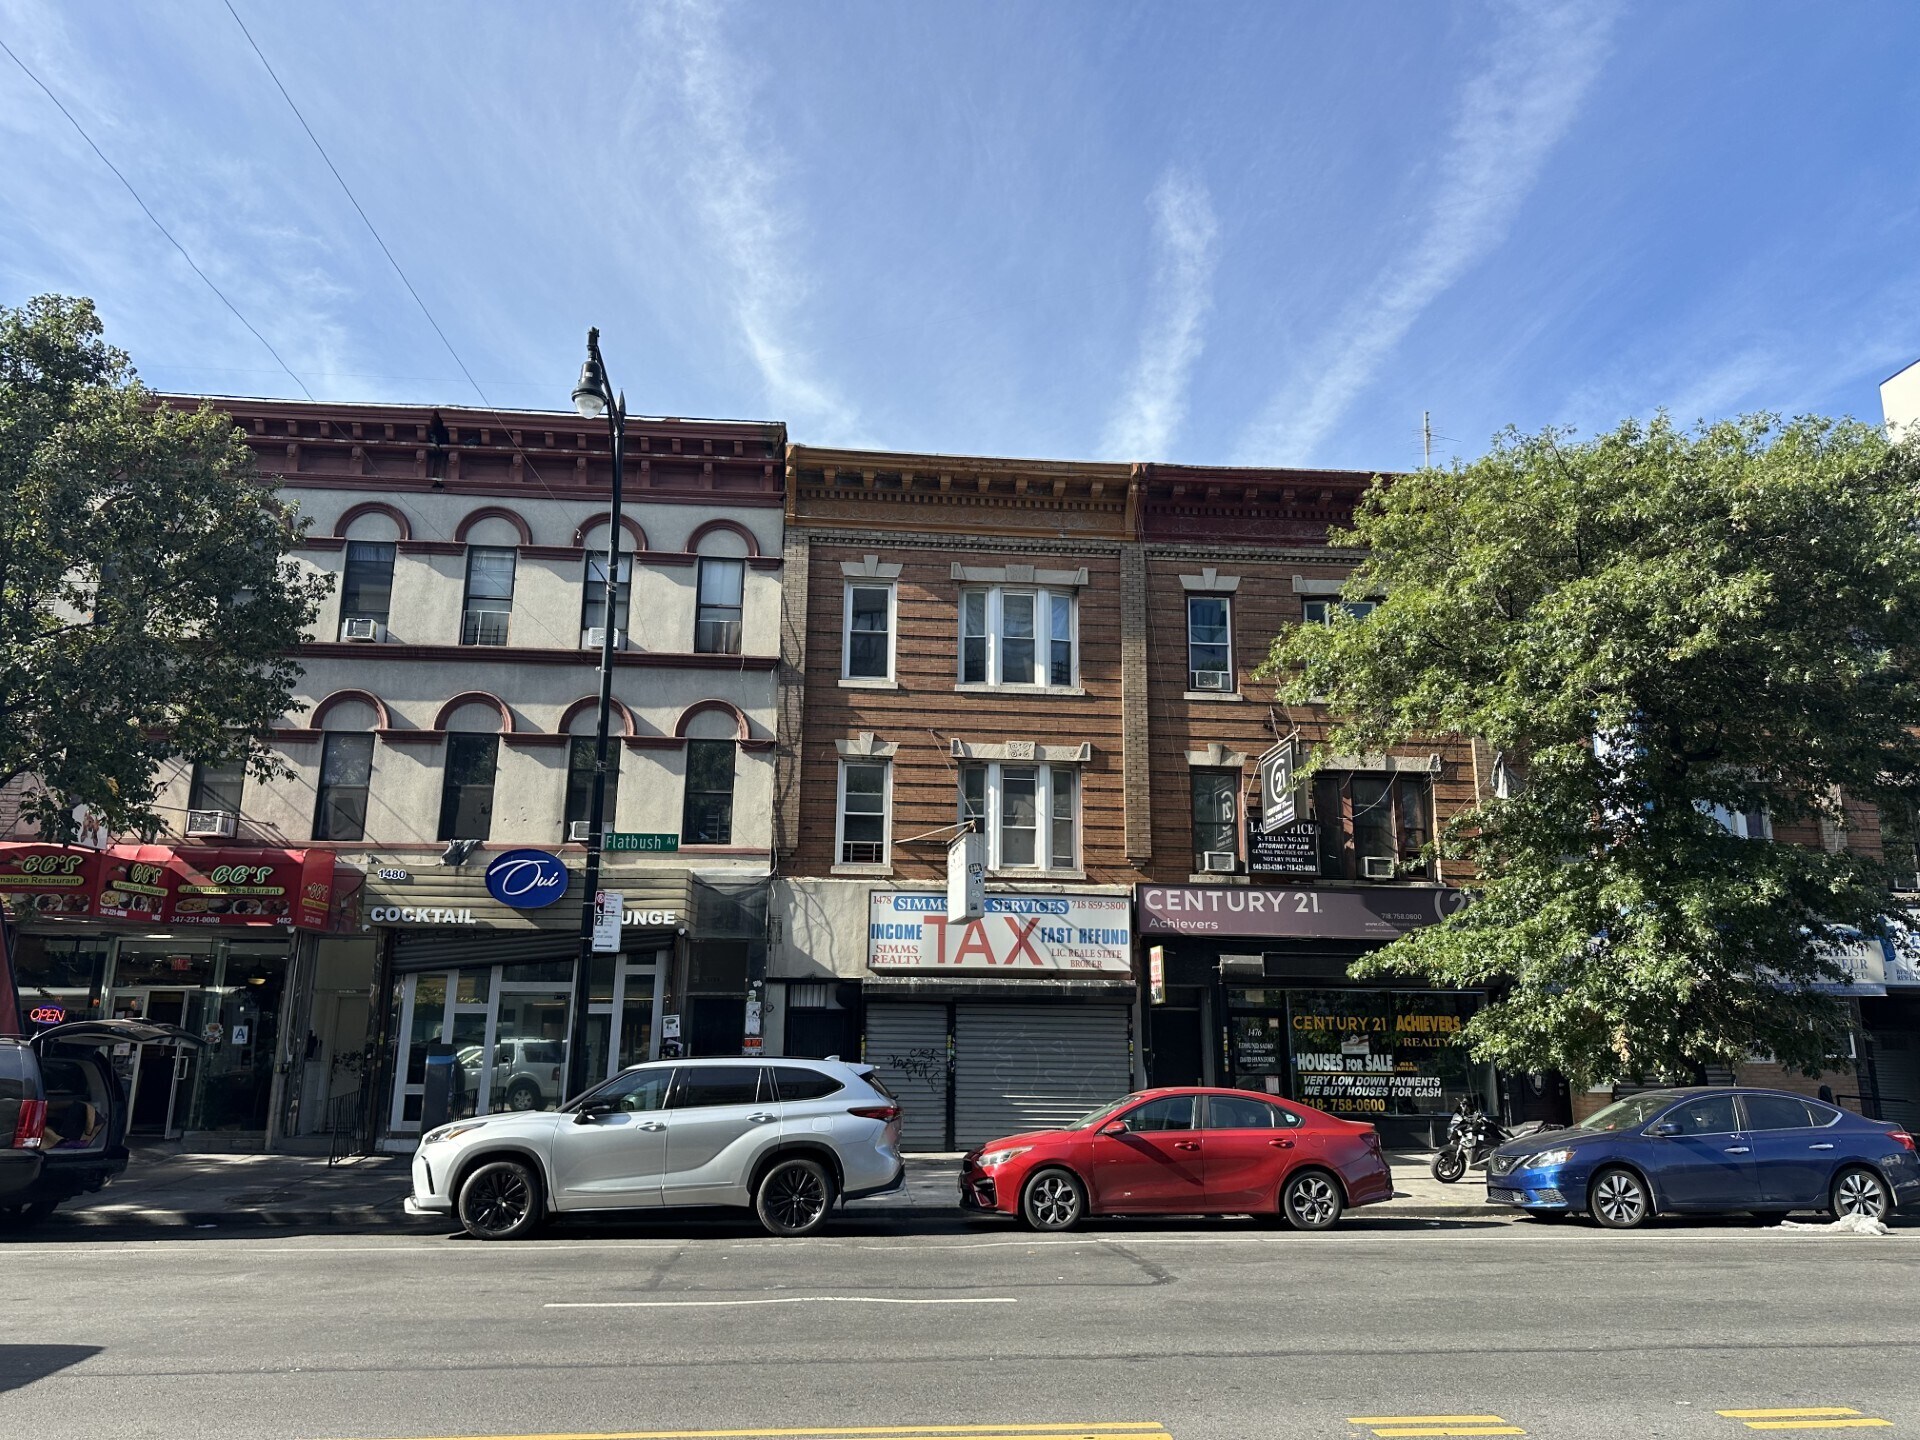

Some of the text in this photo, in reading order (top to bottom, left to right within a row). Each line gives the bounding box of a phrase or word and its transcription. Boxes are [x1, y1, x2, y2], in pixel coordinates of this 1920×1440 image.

[1250, 822, 1264, 833] LA
[606, 835, 676, 849] Flatbush Av
[32, 876, 79, 884] Restaurant
[211, 865, 274, 884] CC'S
[378, 868, 407, 880] 1480
[489, 859, 559, 896] Oui
[182, 885, 280, 895] Jamaican Restaurant
[873, 896, 892, 904] 1478
[897, 897, 949, 910] SIMMS
[1071, 900, 1126, 910] 718 859-5800
[1145, 890, 1319, 913] CENTURY 21
[992, 900, 1066, 913] SERVICES
[170, 915, 220, 924] 347-221-0008
[371, 907, 476, 924] COCKTAIL
[621, 910, 676, 925] UNGE
[1149, 917, 1219, 930] Achievers
[871, 923, 922, 940] INCOME
[1041, 927, 1128, 945] FAST REFUND
[924, 915, 1044, 965] TAX
[876, 944, 918, 954] SIMMS
[1051, 948, 1067, 958] LIC.
[872, 955, 922, 965] REALTY
[1070, 960, 1102, 969] BROKER
[29, 1007, 66, 1022] OPEN
[1293, 1015, 1461, 1031] CENTURY 21 ACHIEVERS
[235, 1028, 245, 1040] A
[1248, 1028, 1263, 1037] 1476
[1403, 1037, 1450, 1047] REALTY
[1297, 1053, 1393, 1072] HOUSES FOR SALE
[1303, 1076, 1441, 1087] VERY LOW DOWN PAYMENTS
[1304, 1086, 1442, 1097] WE BUY HOUSES FOR CASH
[1332, 1098, 1386, 1112] 758-0600
